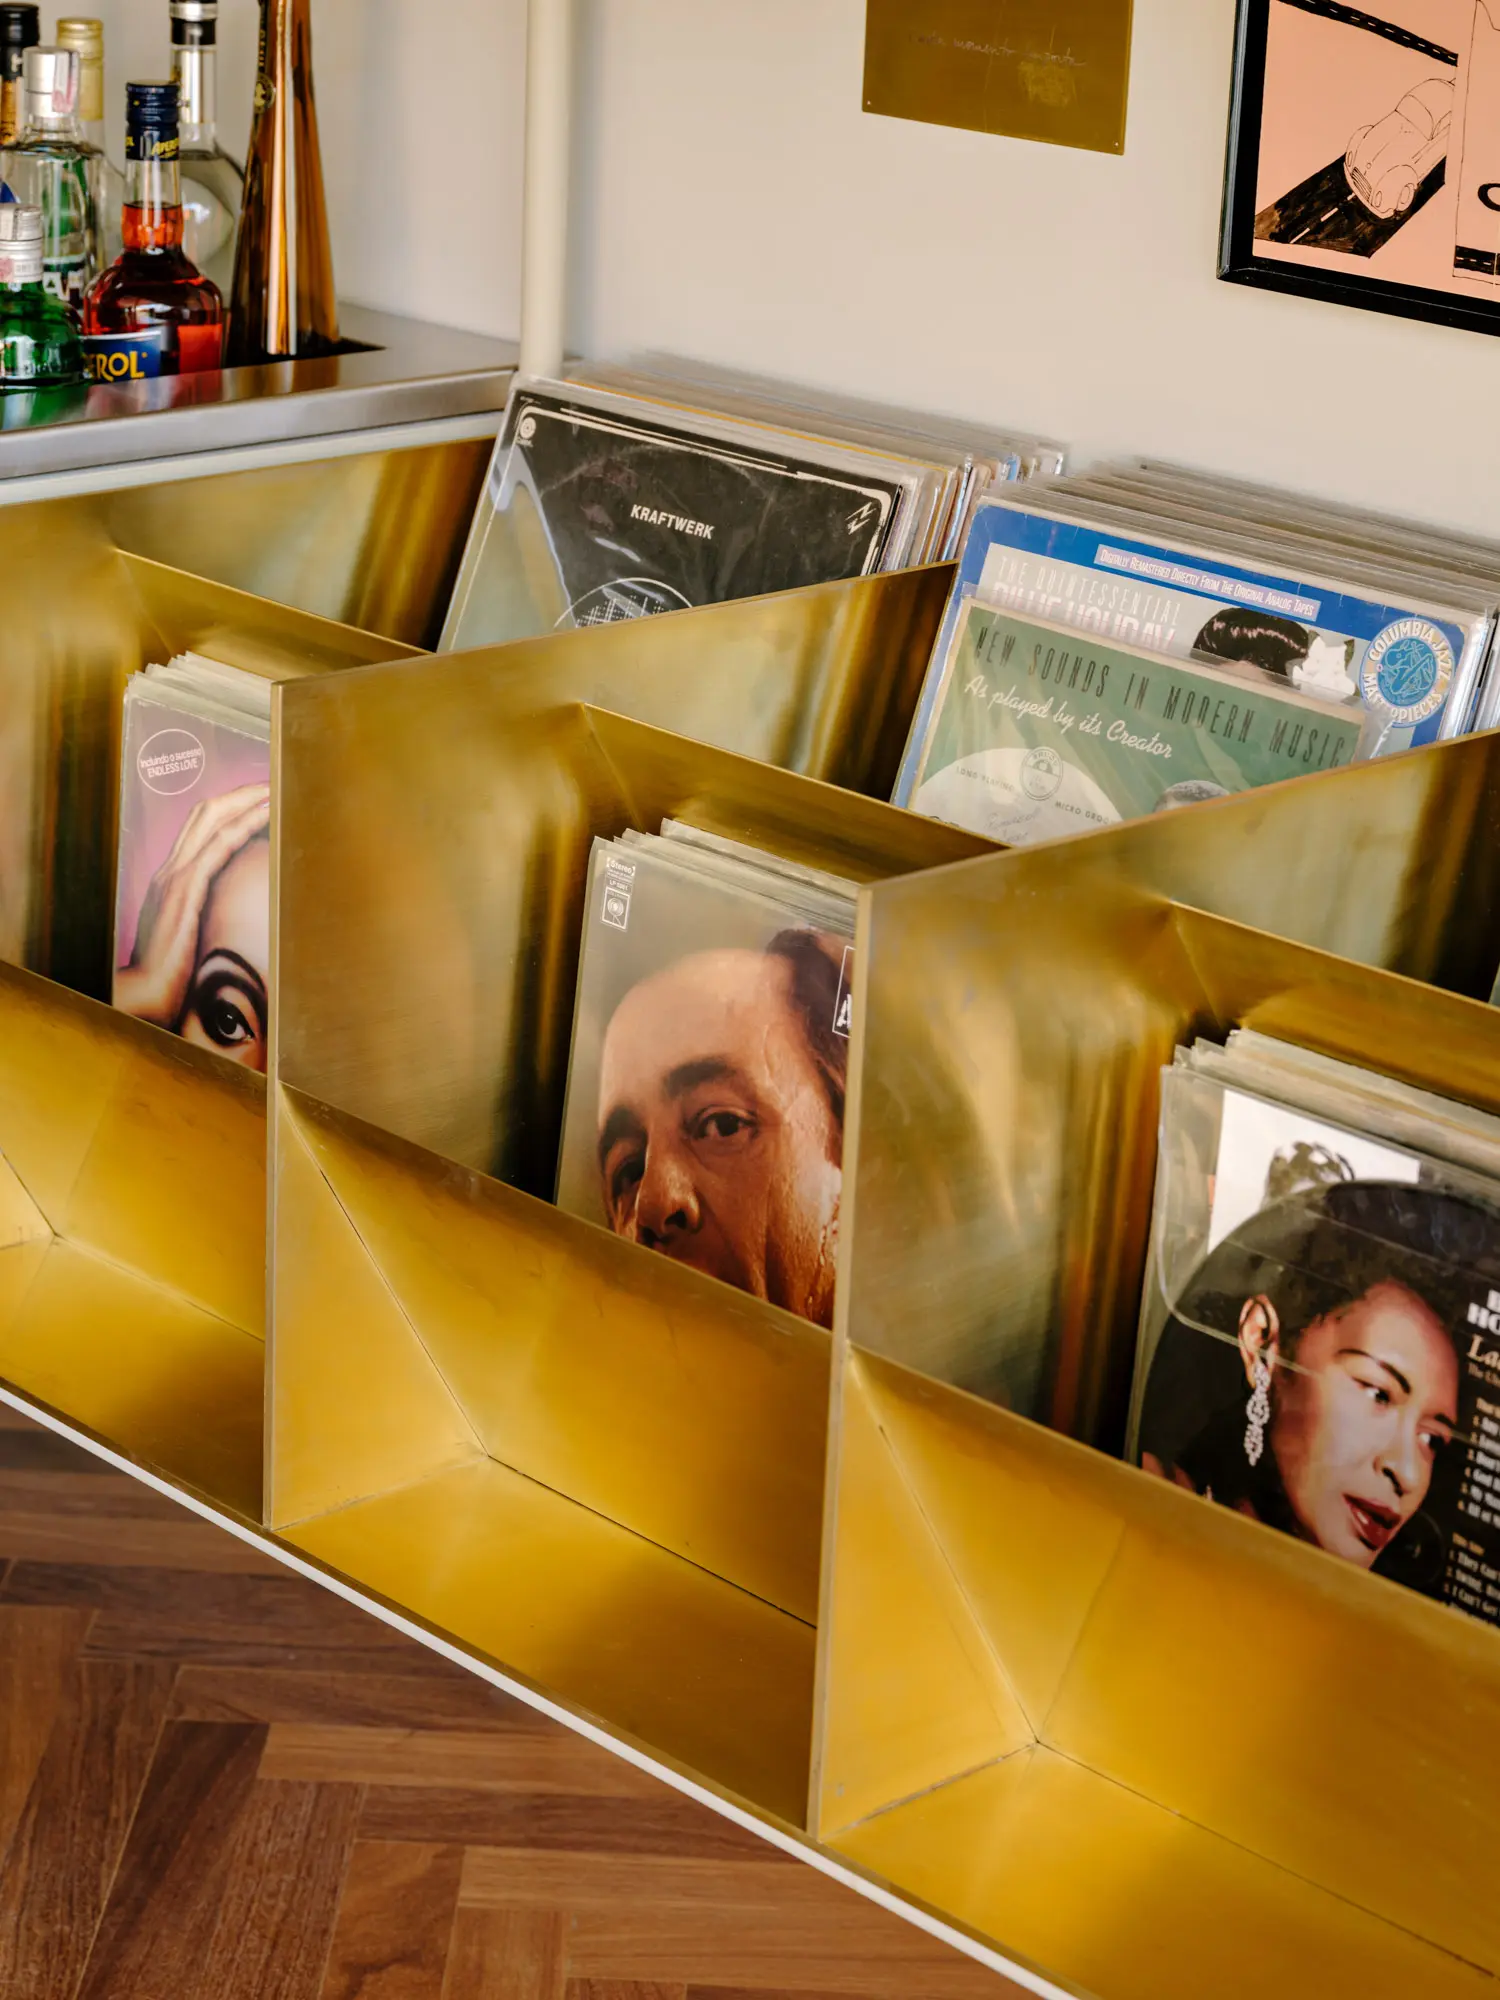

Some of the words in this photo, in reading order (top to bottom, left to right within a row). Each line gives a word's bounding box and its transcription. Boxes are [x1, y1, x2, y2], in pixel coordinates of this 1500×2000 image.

[630, 504, 715, 540] KRAFTWERK
[997, 555, 1029, 586] THE
[1035, 565, 1181, 627] QUINTESSENTIAL
[1099, 549, 1130, 568] DIGITALLY
[1130, 556, 1171, 578] REMASTERED
[1170, 567, 1200, 587] DIRECTLY
[1199, 576, 1220, 592] FROM
[1221, 581, 1234, 595] THE
[1234, 584, 1264, 603] ORIGINAL
[1265, 592, 1292, 610] ANALOG
[1293, 599, 1316, 617] TAPES
[1368, 620, 1434, 662] COLUMBIA
[1432, 640, 1452, 681] JAZZ
[964, 674, 988, 698] As
[986, 684, 1054, 720] played
[1053, 696, 1075, 735] by
[1079, 712, 1102, 735] its
[1106, 719, 1173, 759] Creator
[974, 627, 1015, 668] NEW
[1028, 643, 1110, 698] SOUNDS
[1123, 672, 1150, 711] IN
[1162, 685, 1256, 744] MODERN
[1269, 718, 1346, 769] MUSIC
[1054, 800, 1082, 816] MICRO
